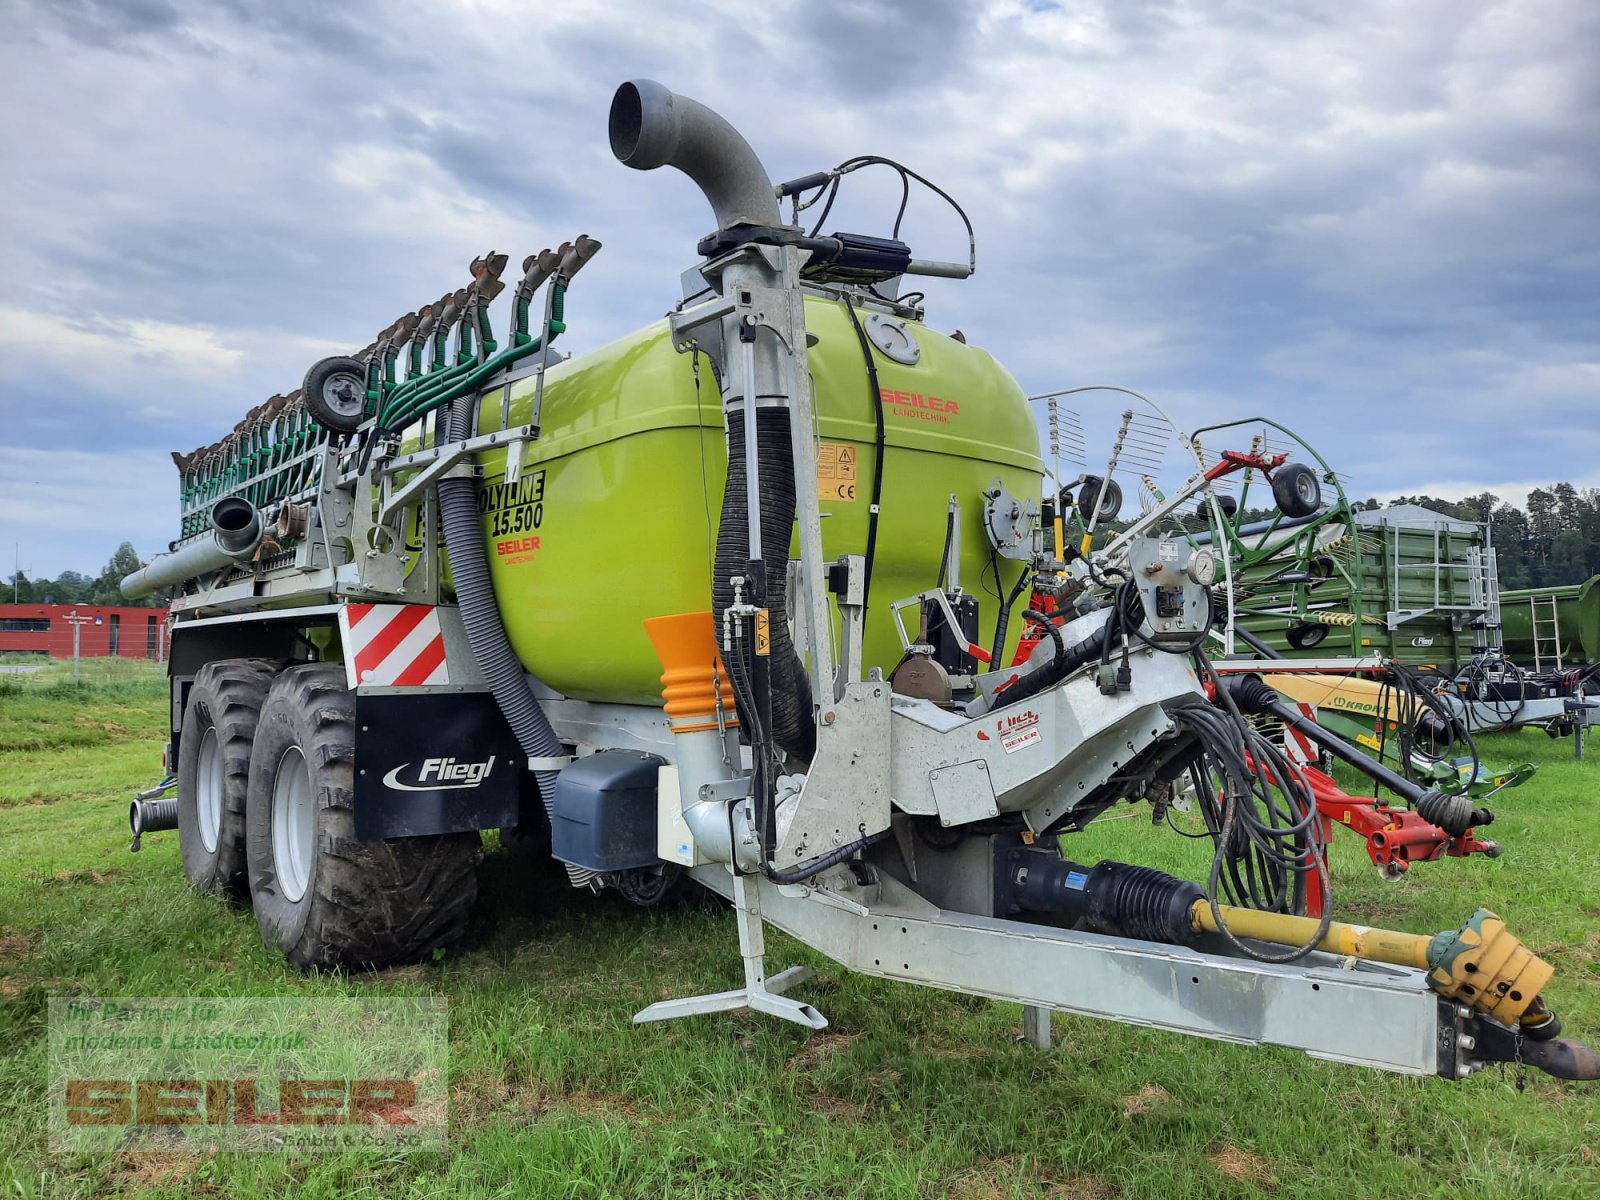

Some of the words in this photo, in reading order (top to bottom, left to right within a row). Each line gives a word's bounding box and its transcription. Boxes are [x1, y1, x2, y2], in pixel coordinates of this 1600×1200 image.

[879, 388, 959, 416] SEILER
[476, 470, 546, 514] OLYLINE
[492, 503, 543, 537] 15.500
[497, 536, 541, 556] SEILER
[418, 755, 496, 784] Fliegl
